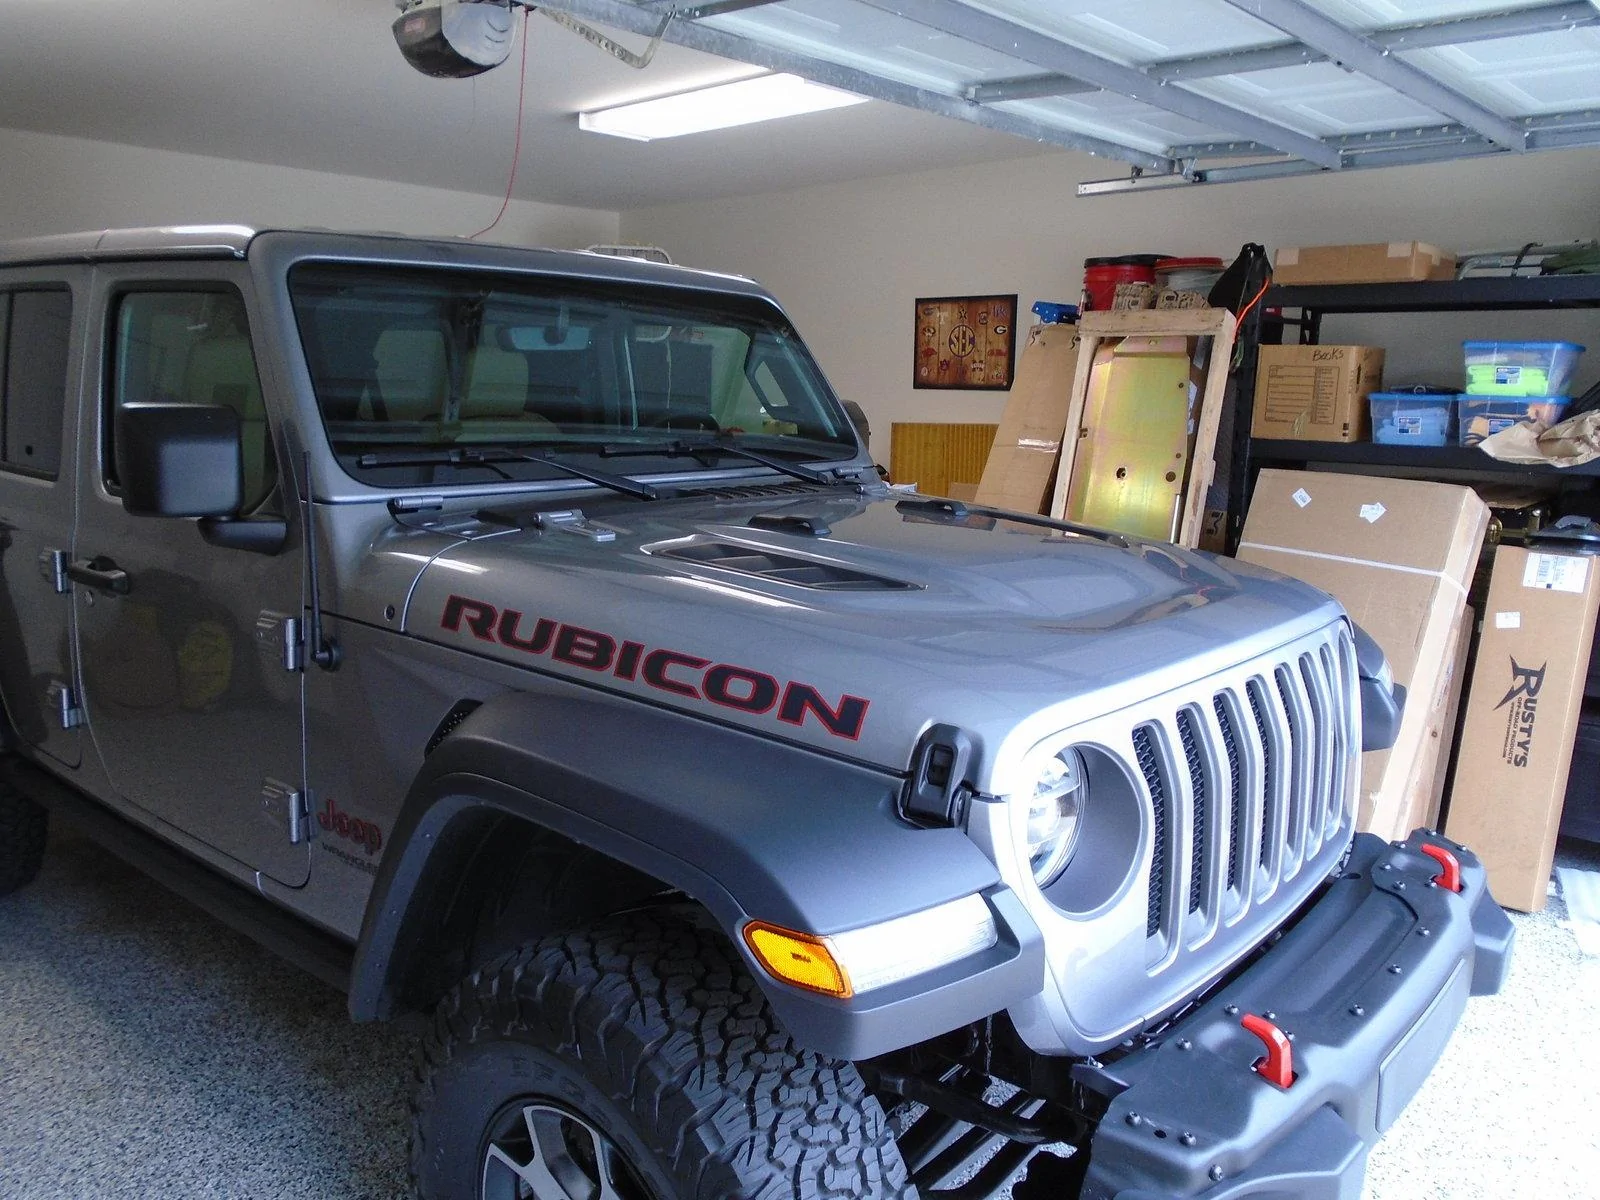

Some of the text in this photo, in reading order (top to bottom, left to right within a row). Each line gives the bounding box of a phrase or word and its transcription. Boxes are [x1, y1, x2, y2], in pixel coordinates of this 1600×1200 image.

[440, 594, 871, 741] RUBICON
[1493, 654, 1547, 768] RUSTY'S
[317, 799, 382, 856] Jeep
